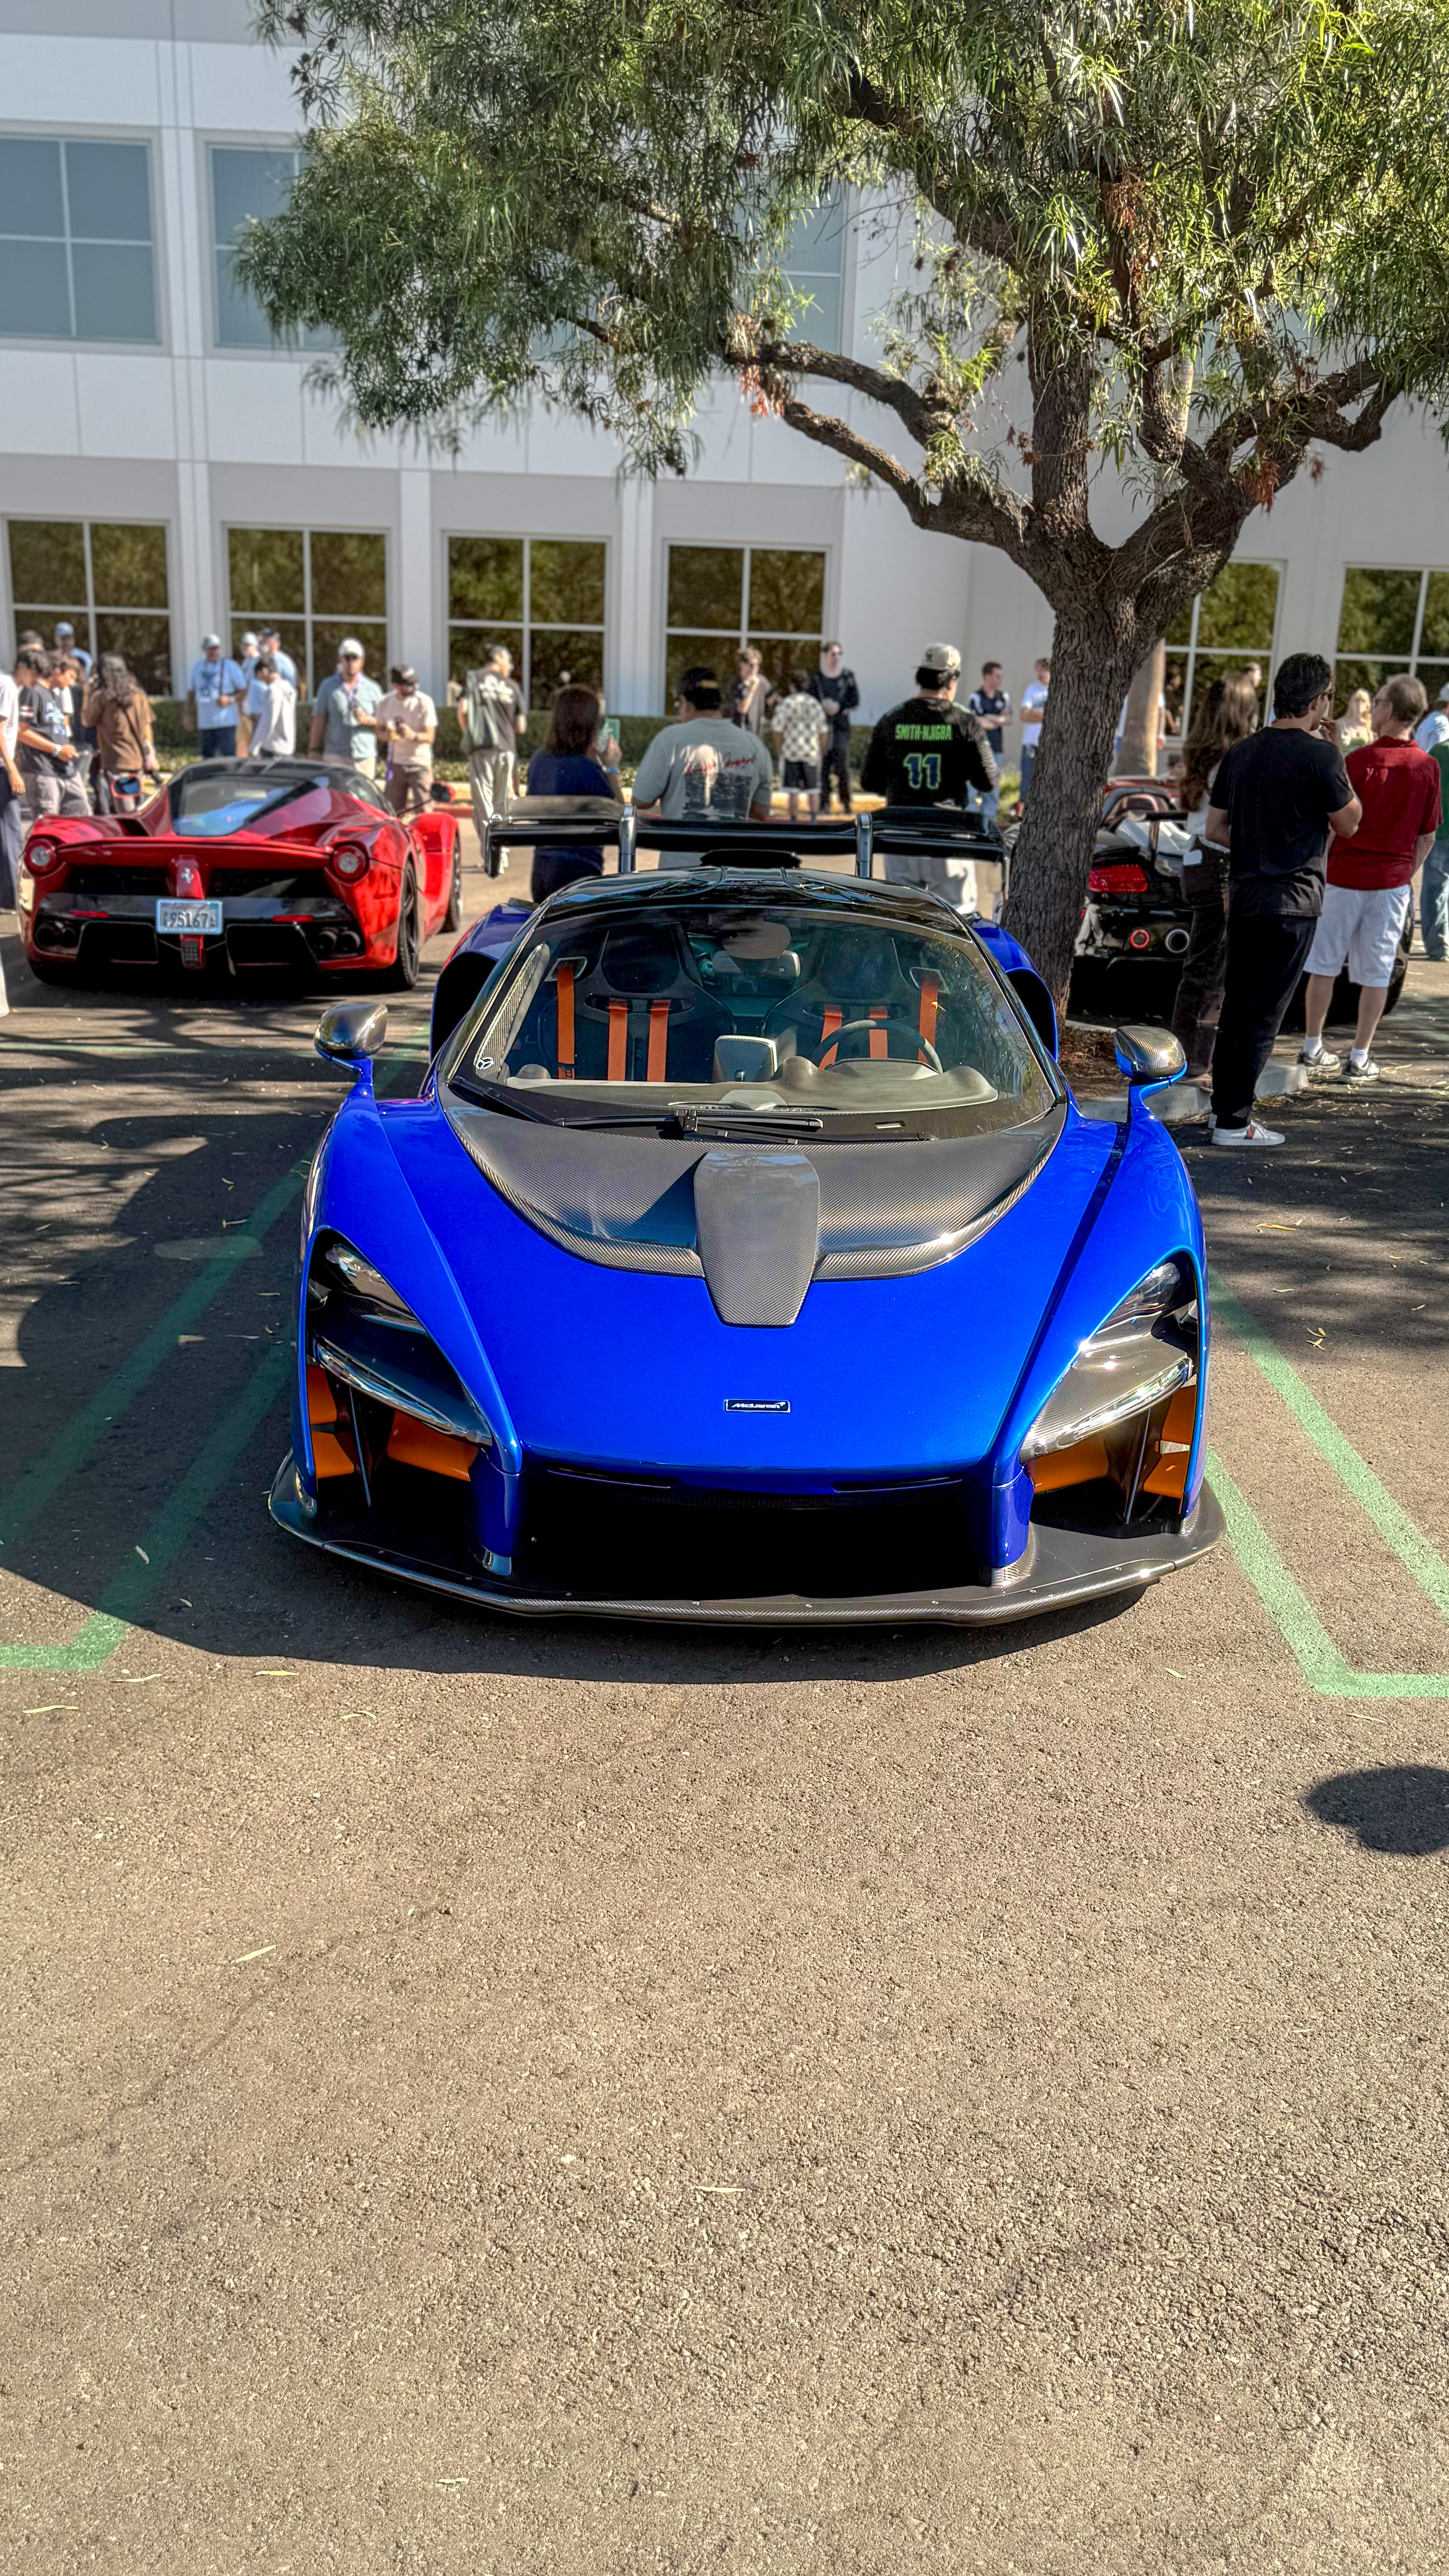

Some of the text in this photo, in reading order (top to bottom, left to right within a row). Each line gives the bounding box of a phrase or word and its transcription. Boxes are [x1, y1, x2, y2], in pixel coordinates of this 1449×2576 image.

[895, 724, 952, 740] SMITH-NJIGBA
[904, 753, 941, 789] 11
[170, 912, 209, 927] 95167
